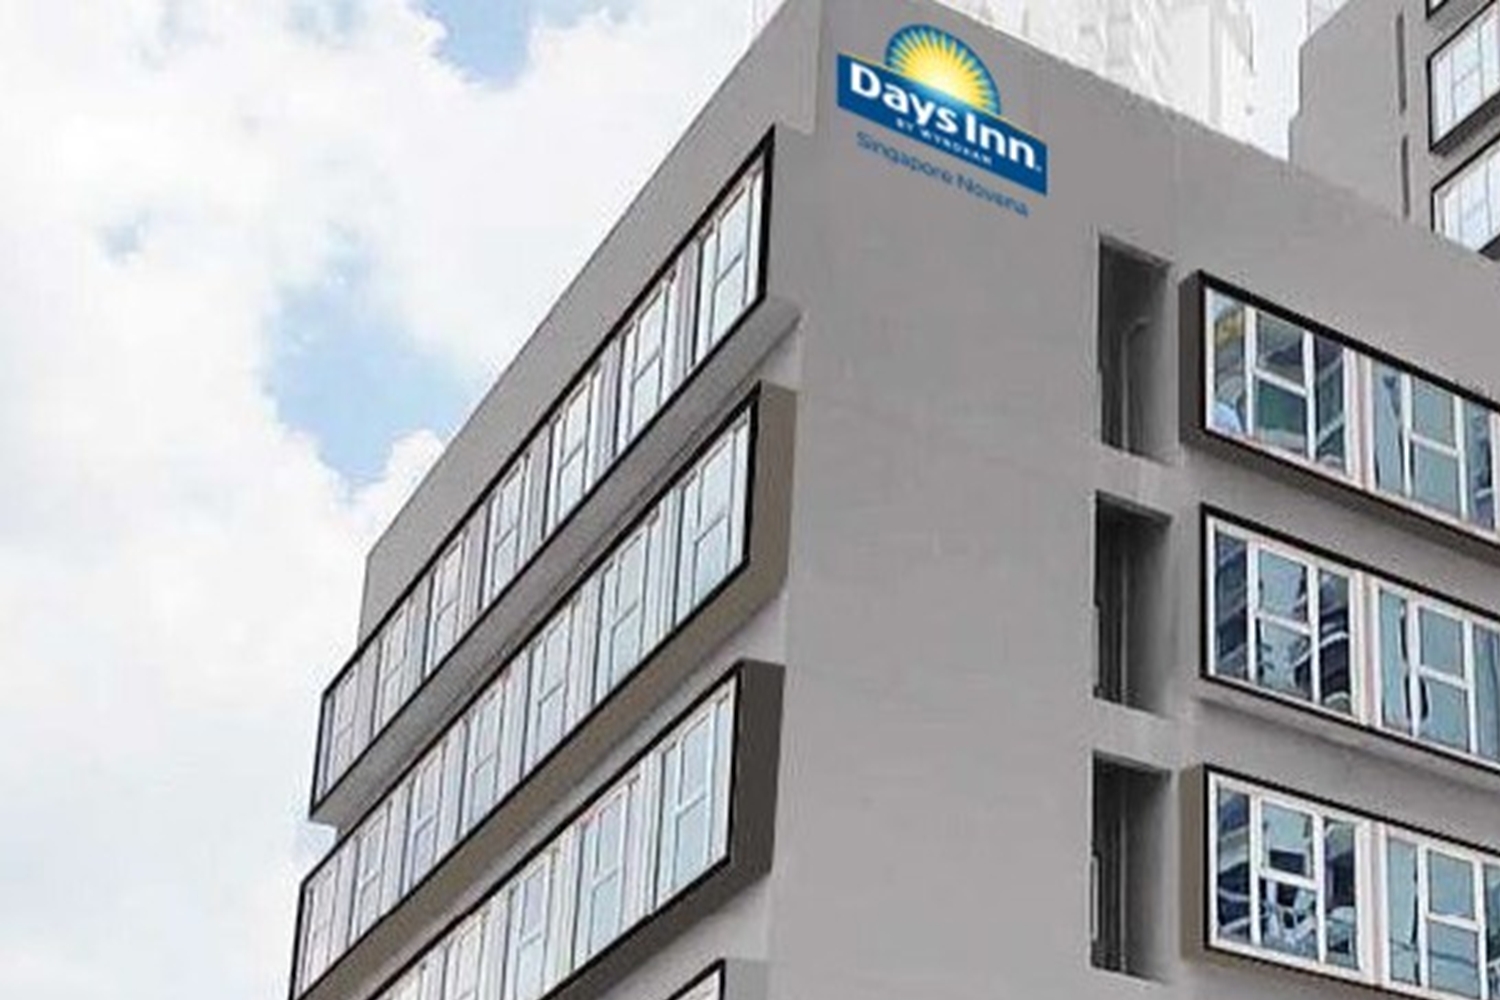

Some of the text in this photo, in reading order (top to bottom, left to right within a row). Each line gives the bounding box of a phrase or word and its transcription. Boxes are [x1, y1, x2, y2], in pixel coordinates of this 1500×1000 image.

[851, 62, 1036, 170] Days Inn
[856, 130, 1030, 218] Singapore Novena
